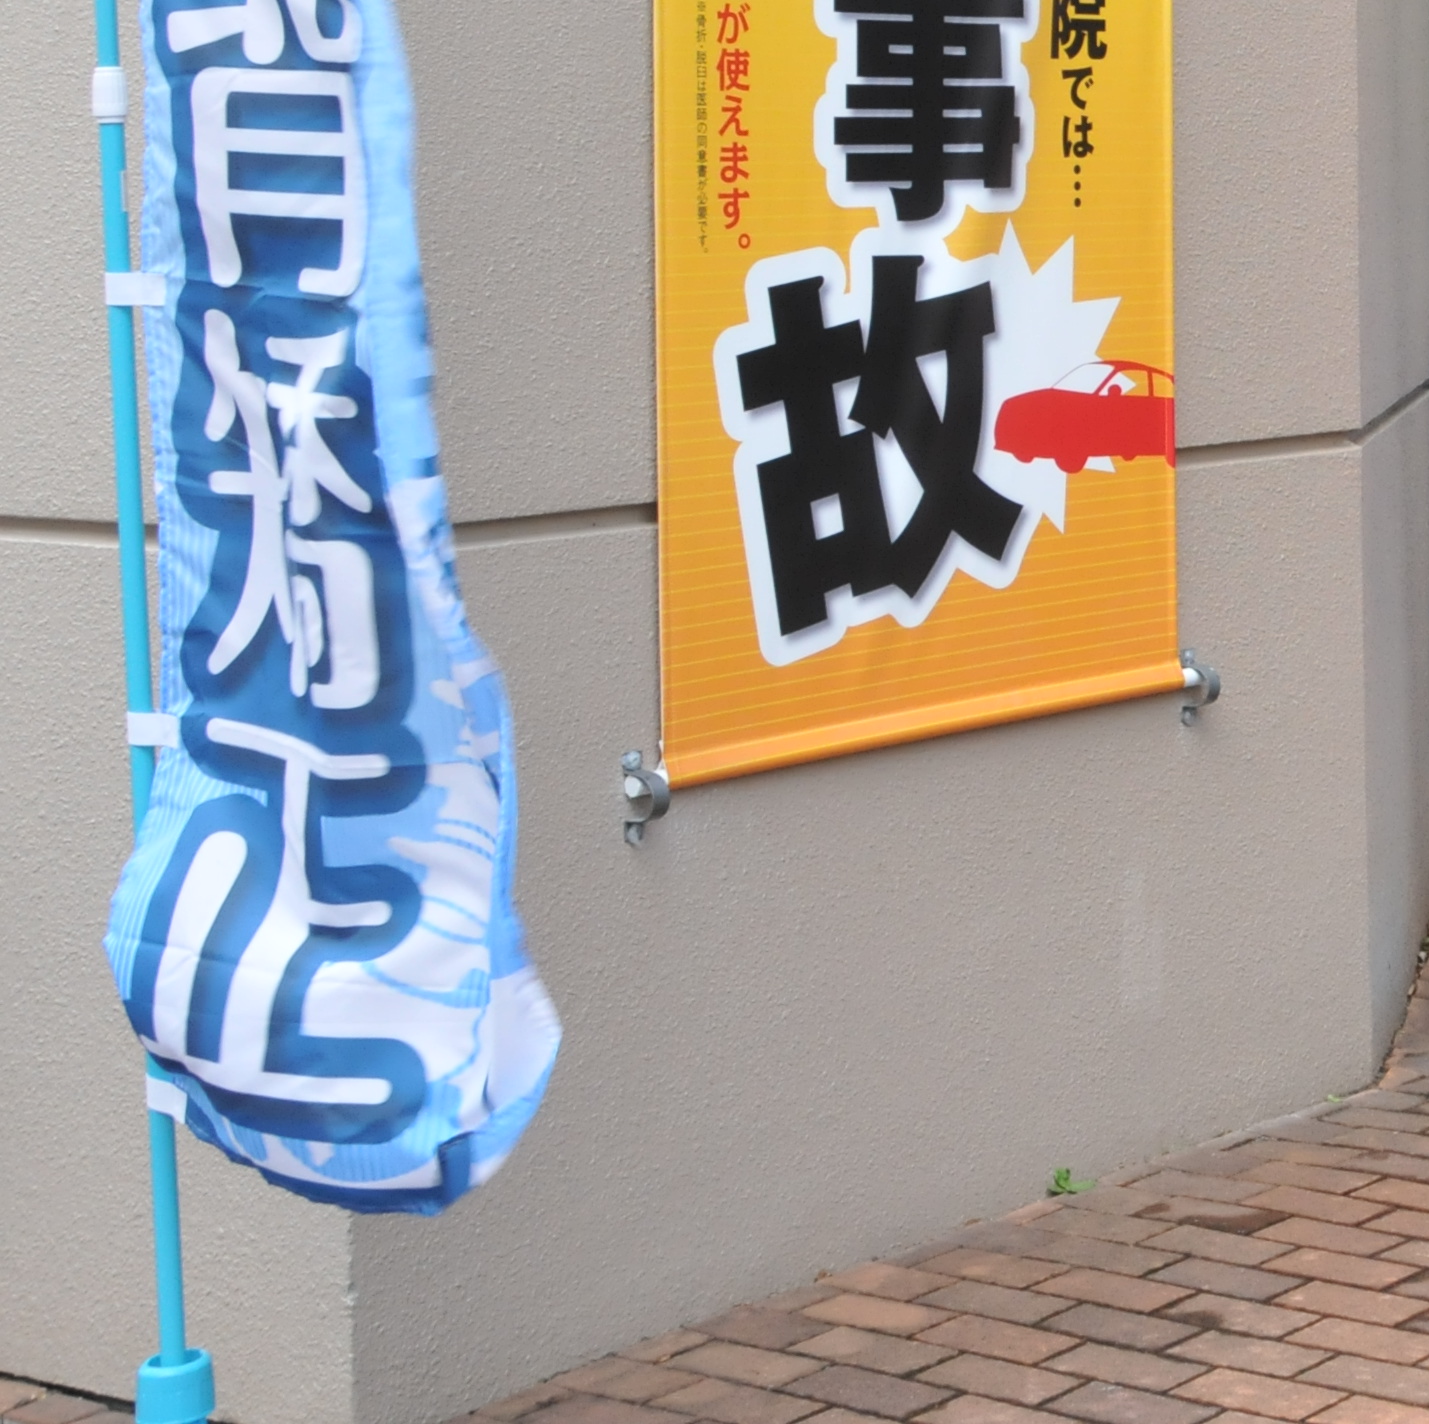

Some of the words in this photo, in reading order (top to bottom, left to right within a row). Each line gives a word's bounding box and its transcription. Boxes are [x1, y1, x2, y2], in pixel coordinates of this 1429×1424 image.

[716, 2, 752, 250] が使えます。
